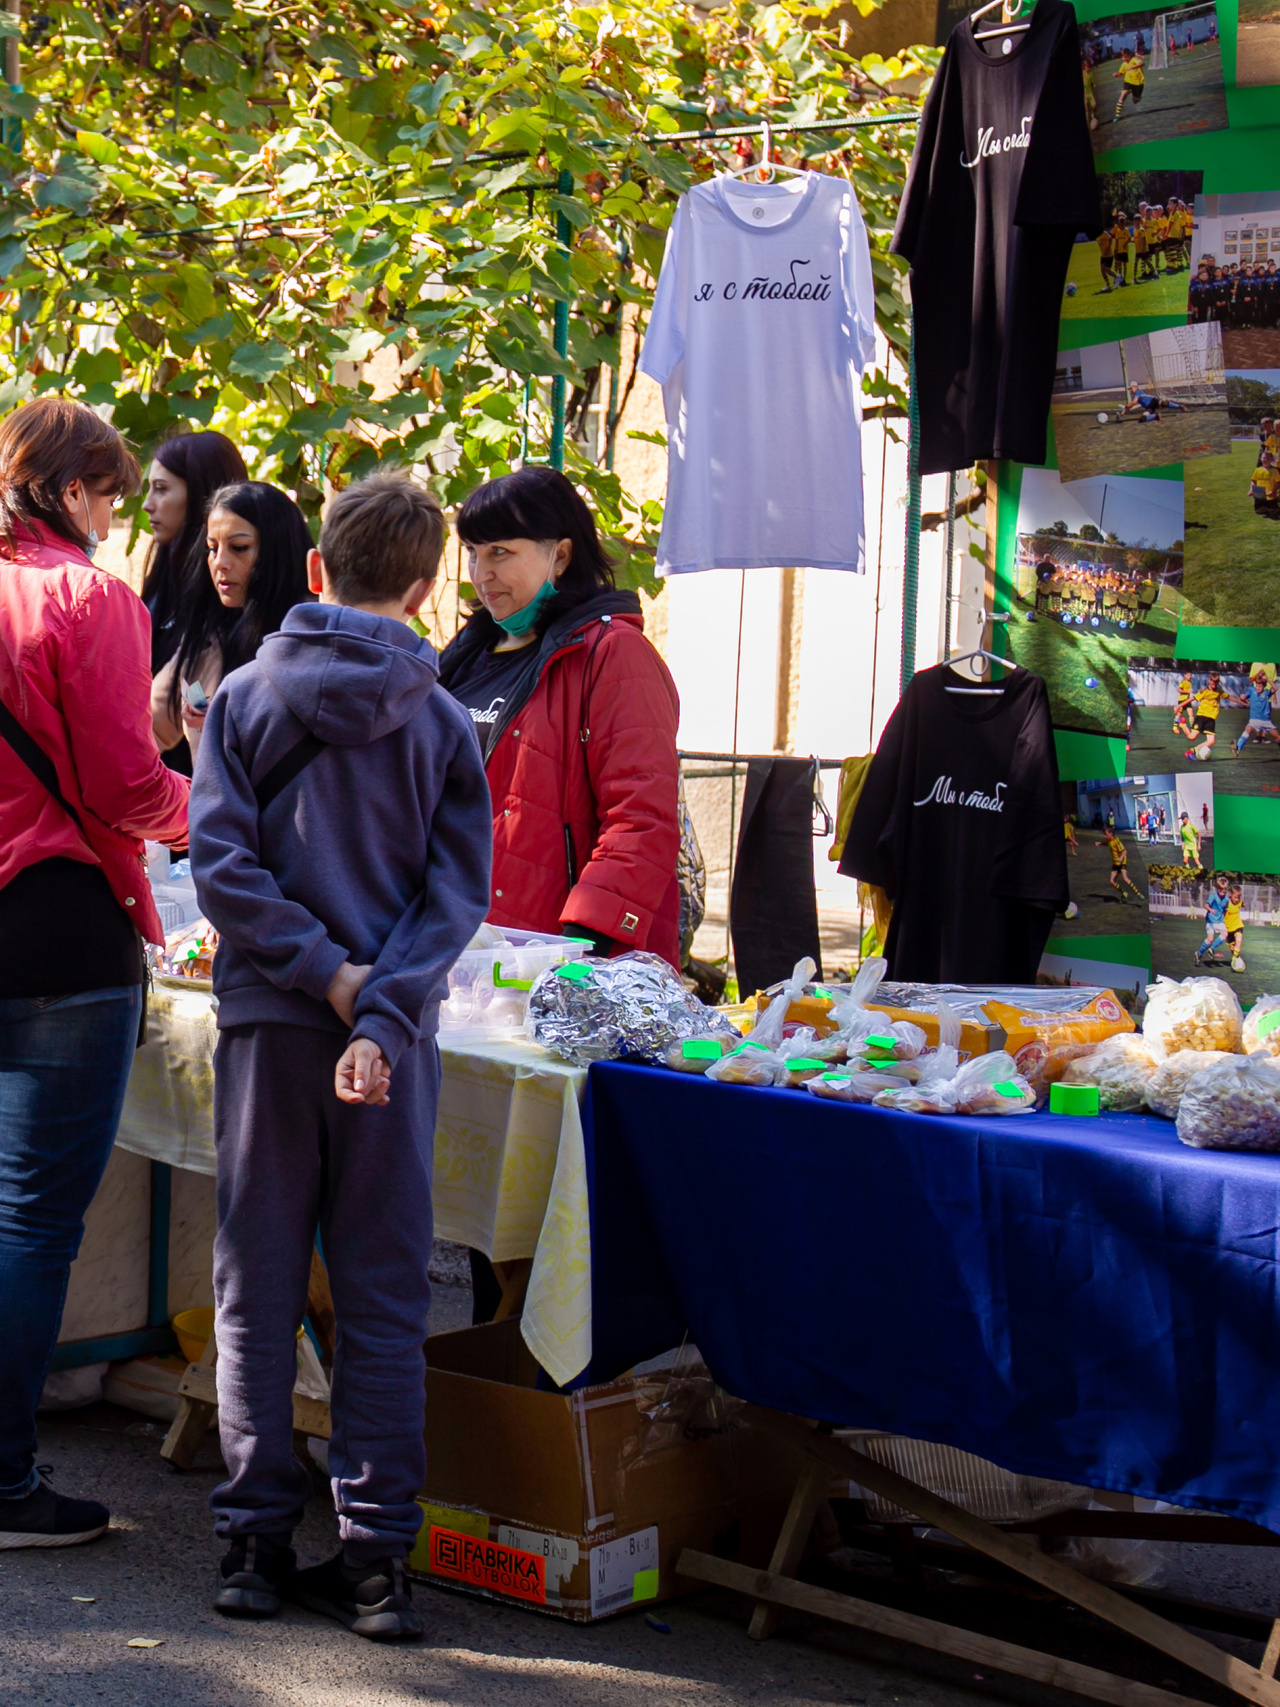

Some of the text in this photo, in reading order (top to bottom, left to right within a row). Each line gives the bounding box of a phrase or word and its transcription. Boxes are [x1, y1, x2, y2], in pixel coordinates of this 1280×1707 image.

[694, 259, 832, 302] я с тобой
[463, 1540, 540, 1582] FABRIKA
[464, 1562, 540, 1597] FUTBOLOK
